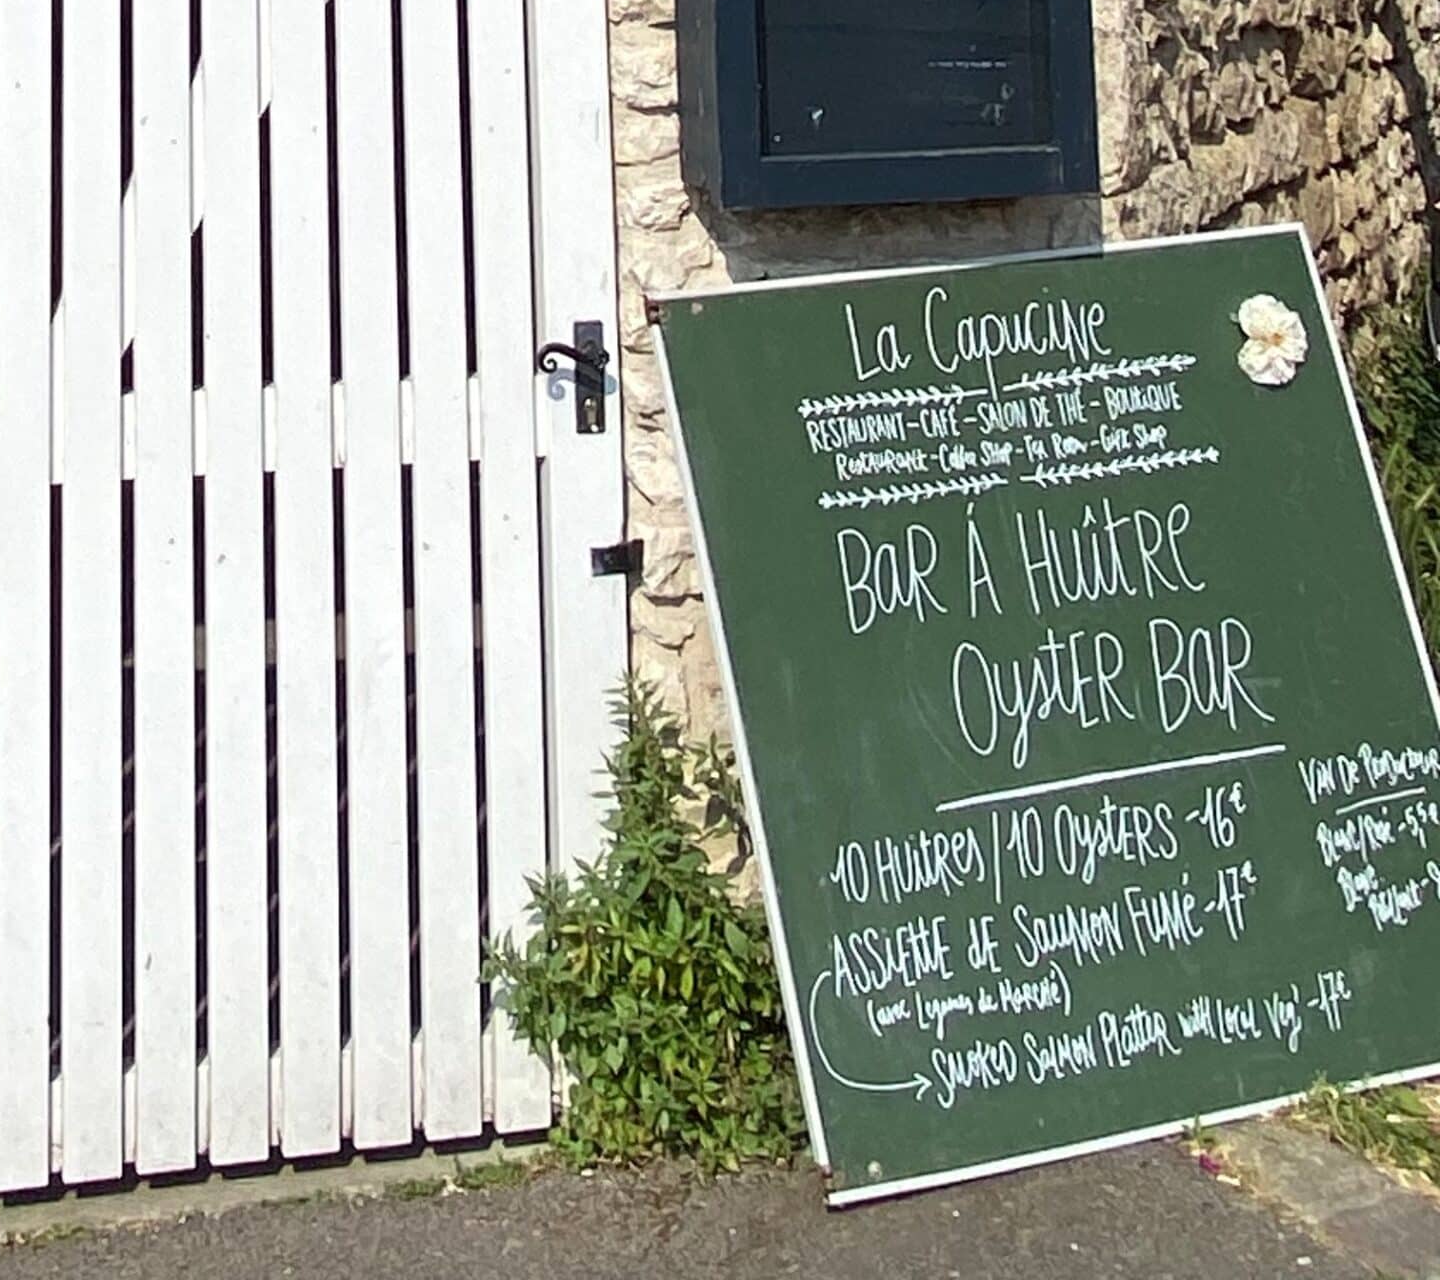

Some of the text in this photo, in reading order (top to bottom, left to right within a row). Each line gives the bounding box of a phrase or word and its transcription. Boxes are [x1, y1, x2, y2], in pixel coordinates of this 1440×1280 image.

[844, 303, 912, 382] La
[806, 412, 906, 454] RESTAURANT
[977, 396, 1028, 434] SALON
[1030, 394, 1052, 428] DE
[829, 840, 871, 904] 10
[1004, 805, 1044, 879] 10
